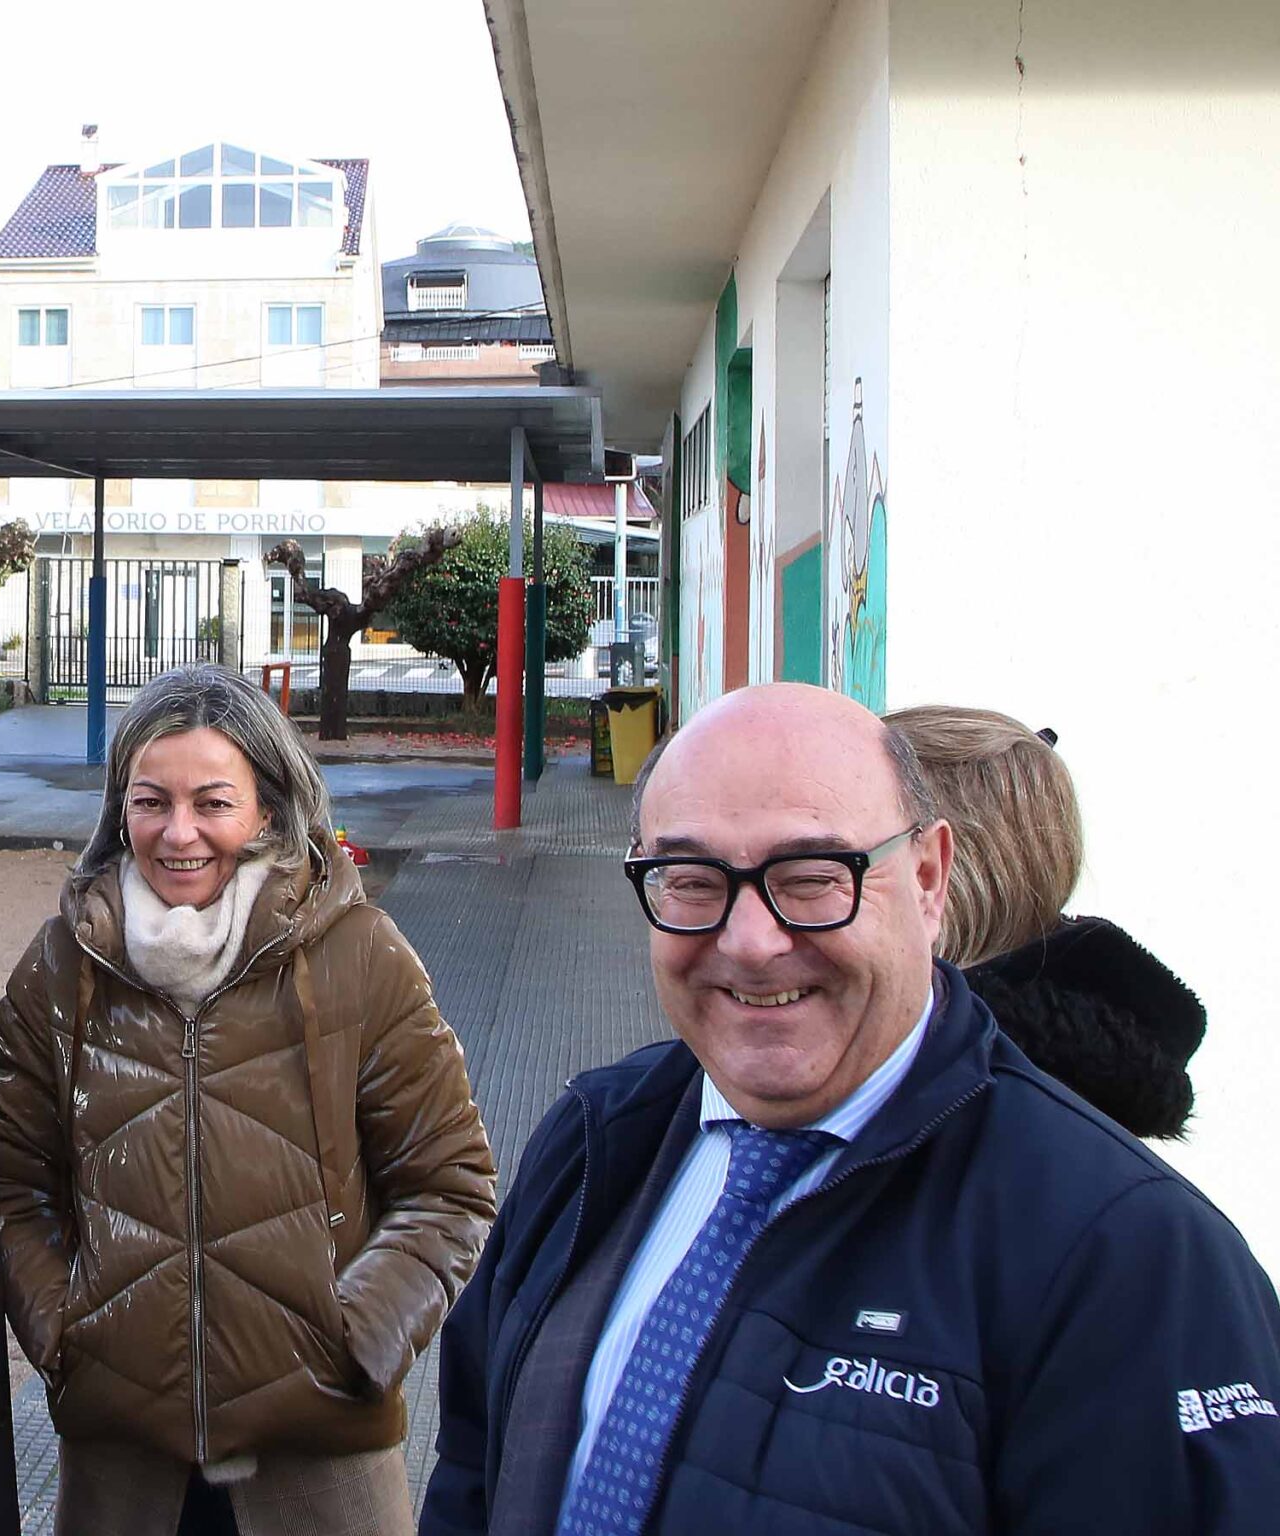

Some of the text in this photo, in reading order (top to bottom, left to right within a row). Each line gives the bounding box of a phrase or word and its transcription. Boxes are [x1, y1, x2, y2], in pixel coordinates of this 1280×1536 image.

[36, 511, 166, 531] VELAORIO
[178, 512, 206, 531] DE
[218, 509, 326, 533] PORRIÑO
[1200, 1381, 1260, 1407] XUNTA
[1207, 1403, 1236, 1422] DE
